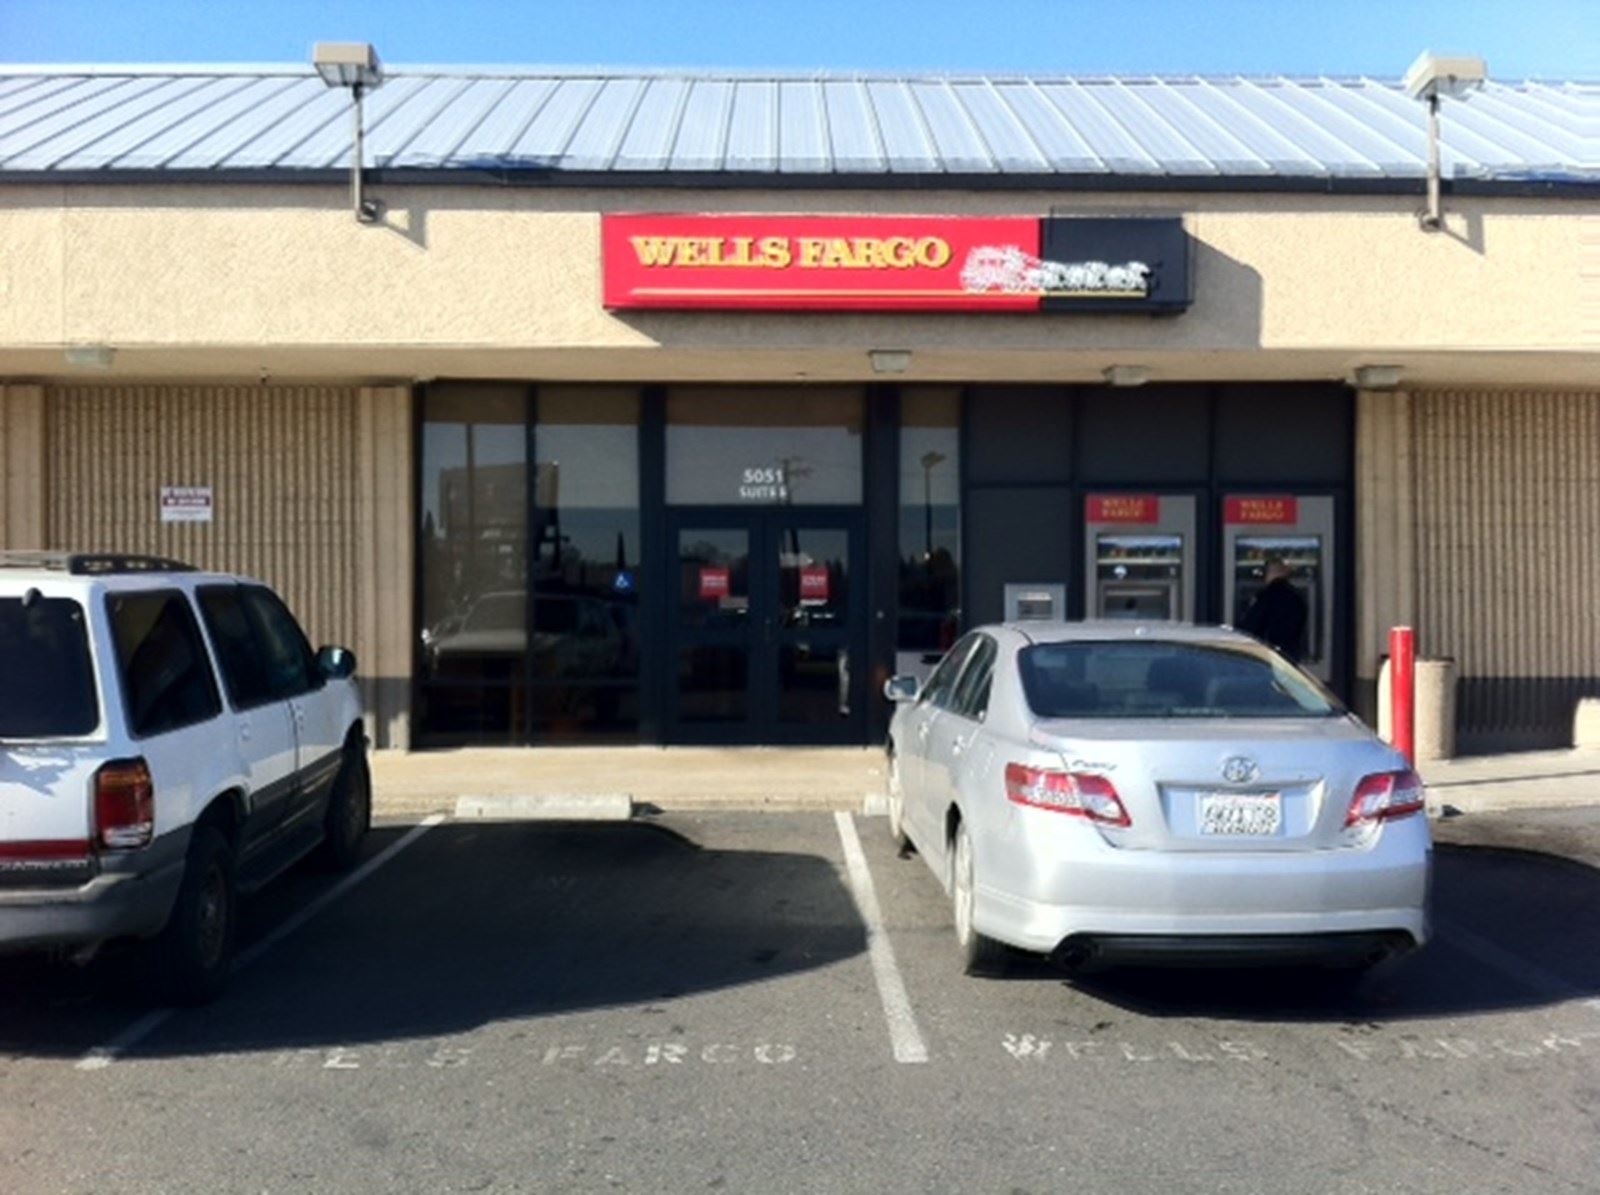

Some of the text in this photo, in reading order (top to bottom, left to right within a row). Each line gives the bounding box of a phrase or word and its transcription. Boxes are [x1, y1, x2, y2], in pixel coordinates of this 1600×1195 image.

[630, 235, 953, 268] WELLS FARGO
[742, 468, 784, 484] 5051
